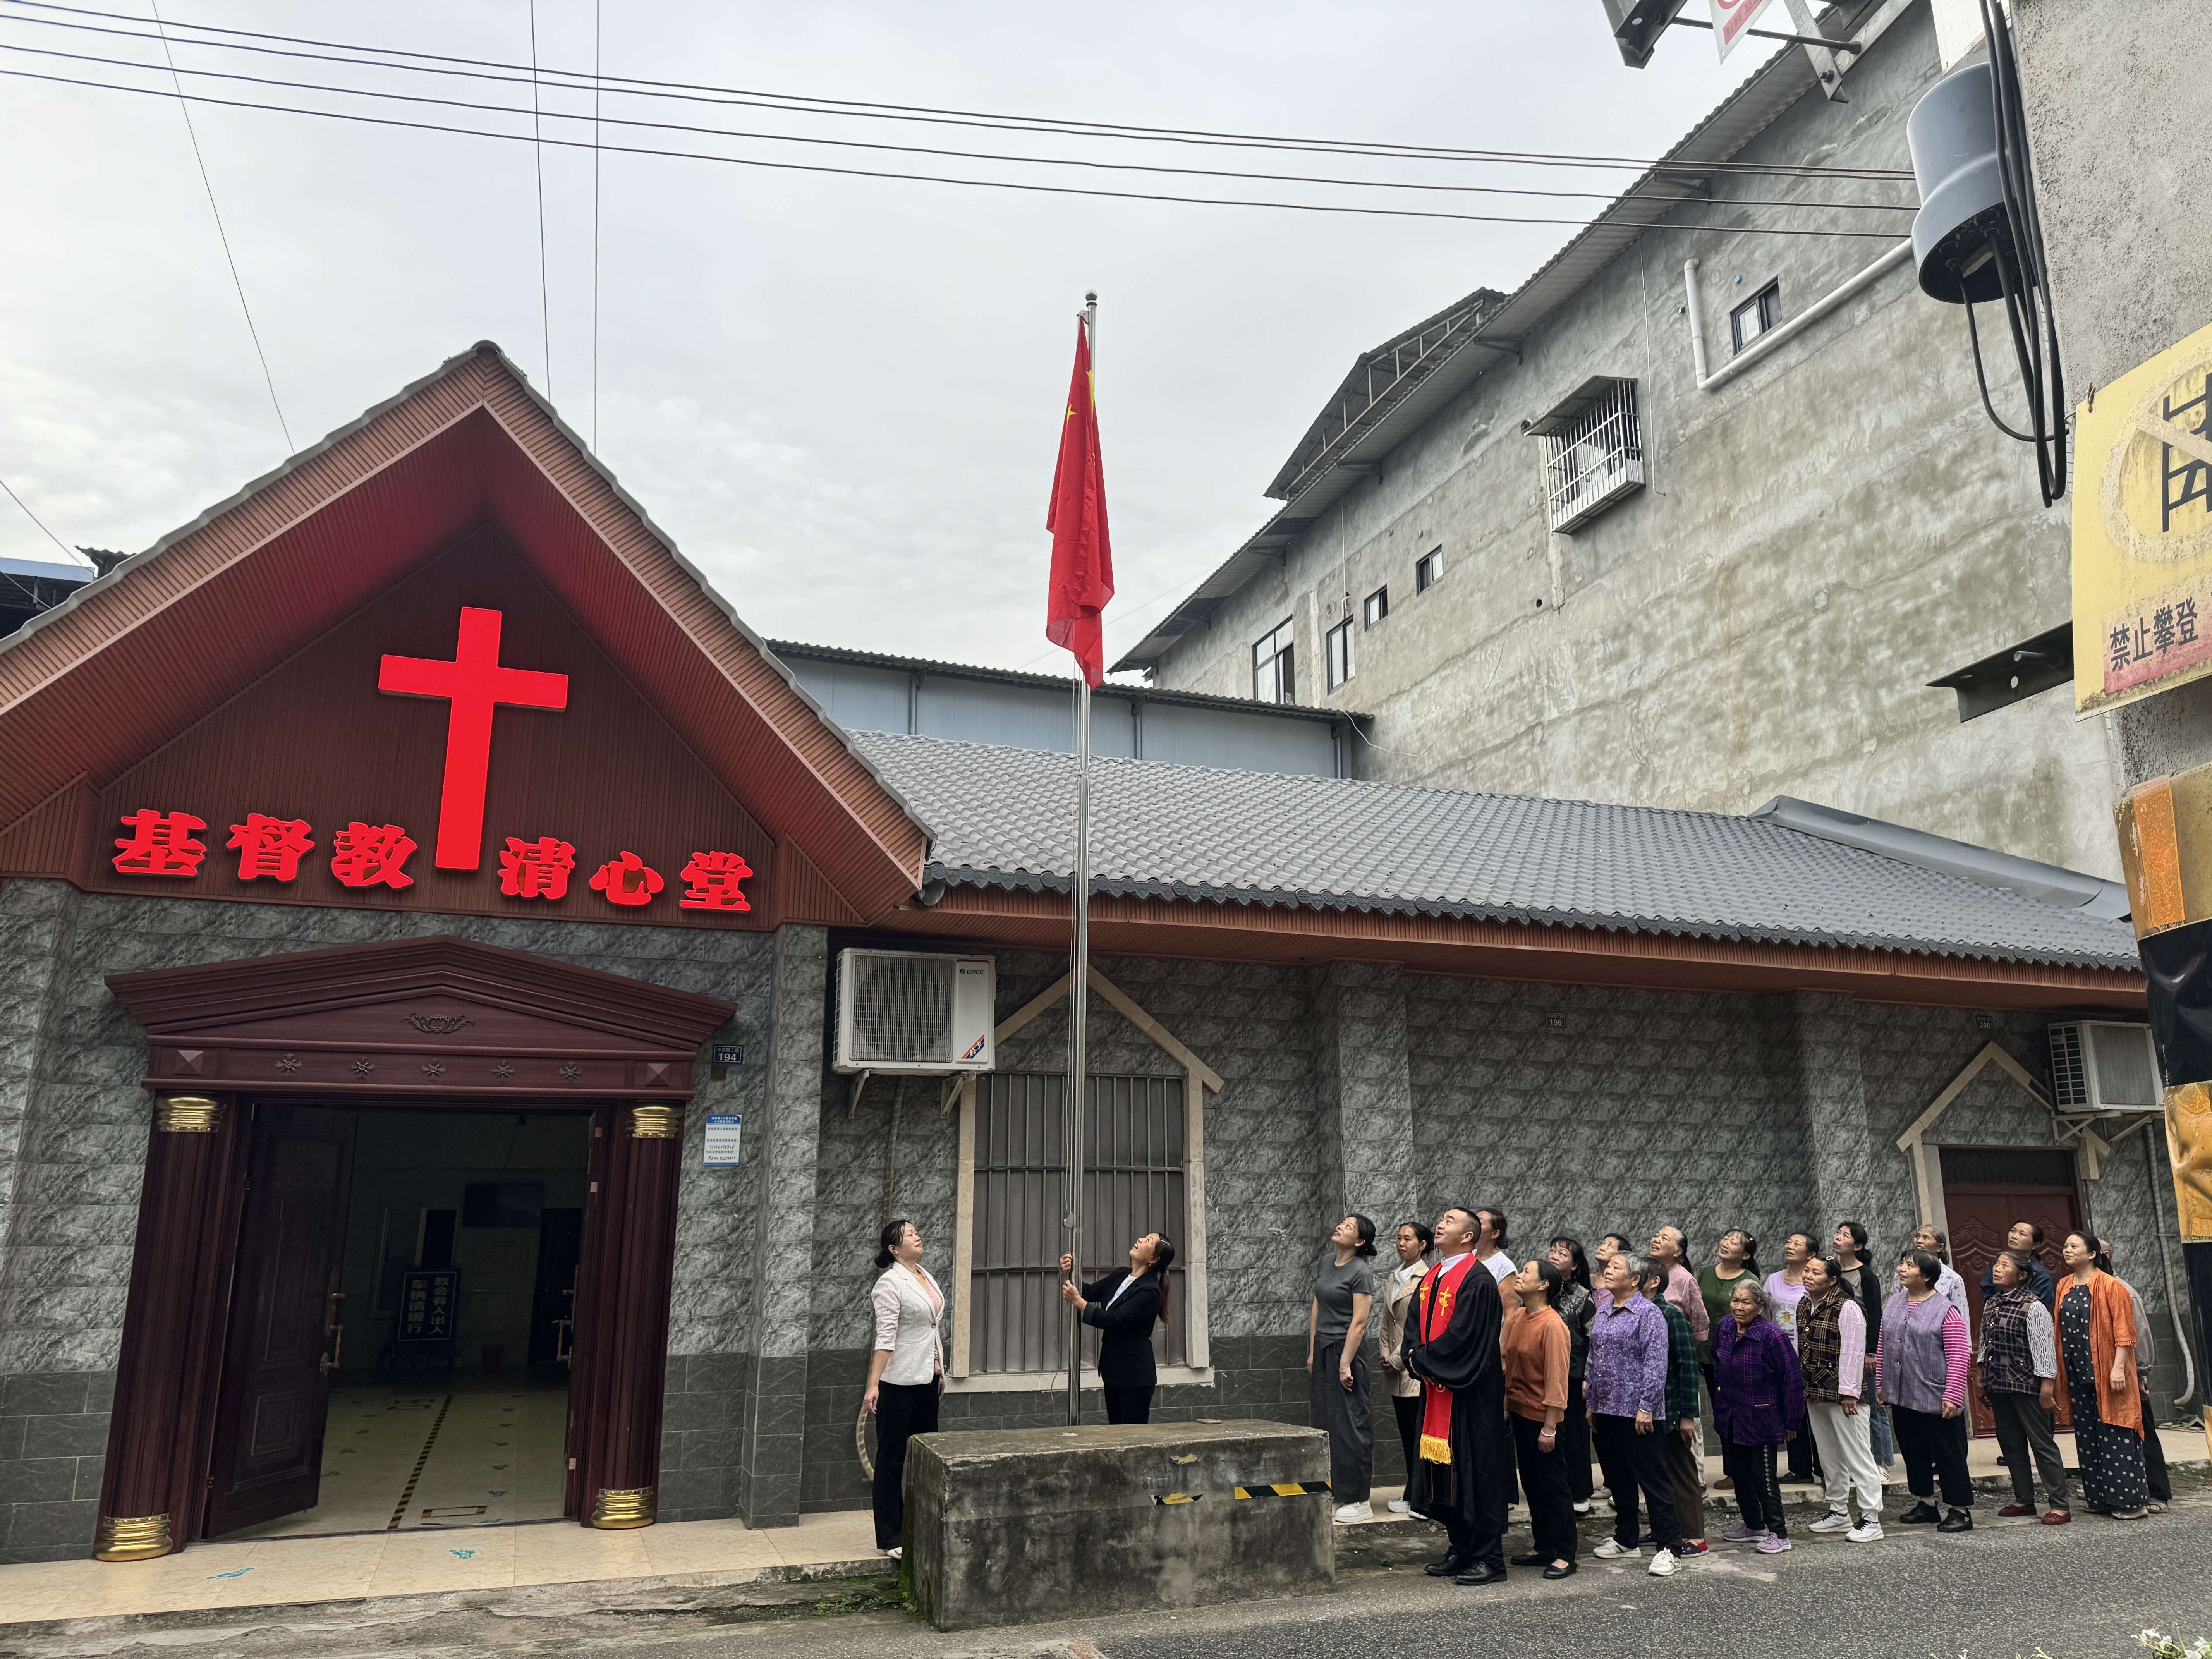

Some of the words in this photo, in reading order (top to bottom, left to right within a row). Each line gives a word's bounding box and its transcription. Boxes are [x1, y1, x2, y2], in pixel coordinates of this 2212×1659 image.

[2110, 596, 2199, 673] 禁止攀登
[112, 808, 418, 889] 基督教
[498, 836, 754, 912] 清心堂
[719, 1053, 737, 1061] 194
